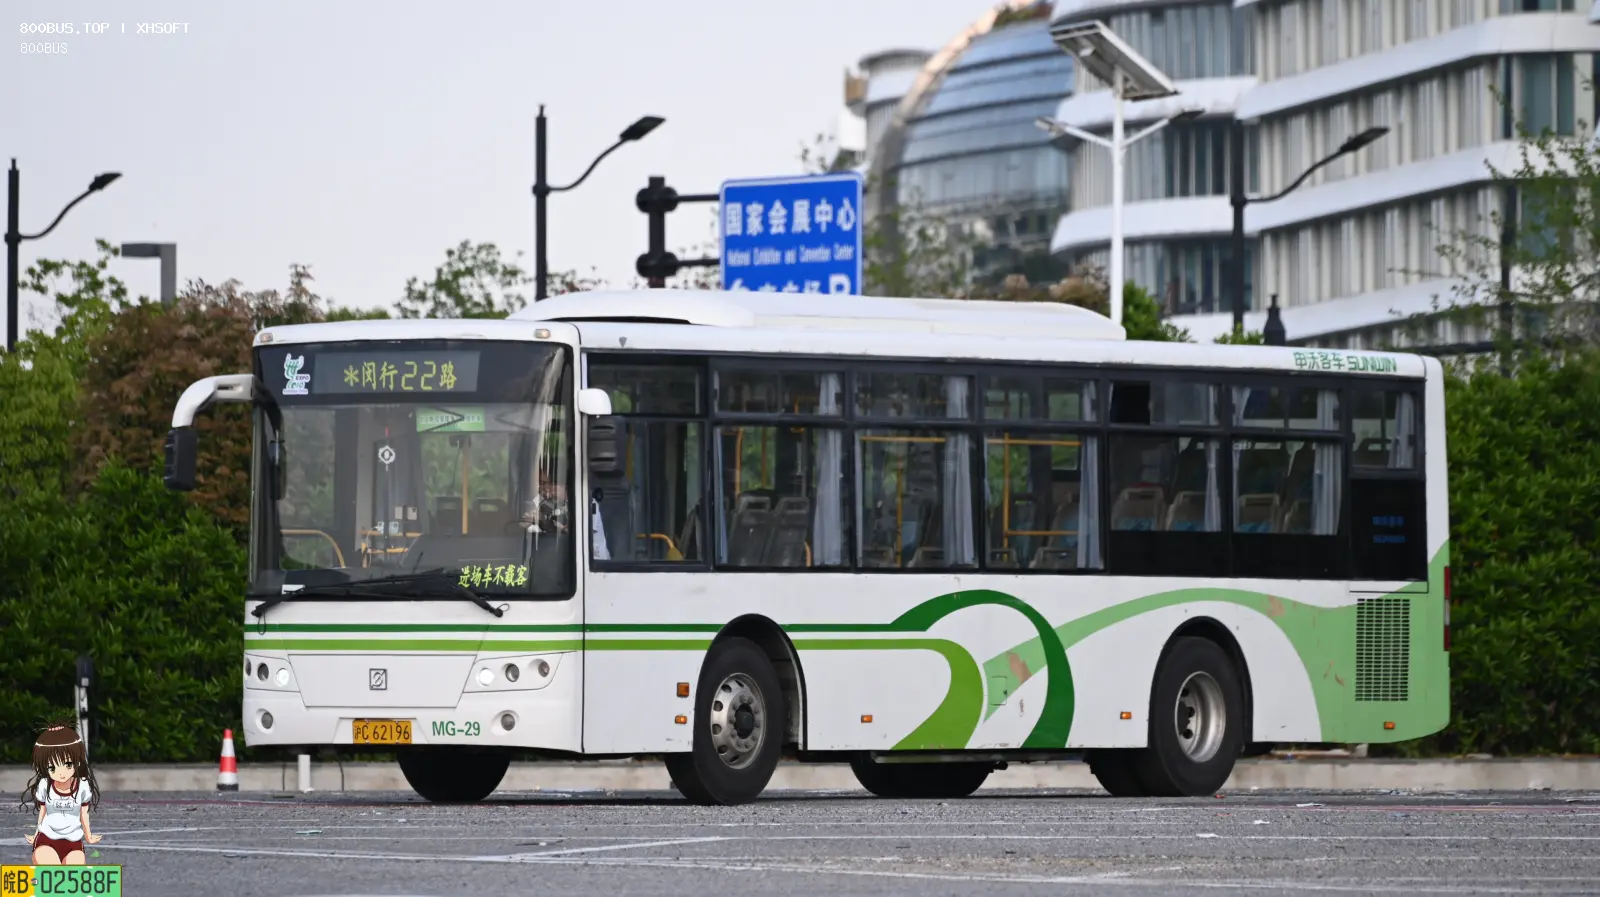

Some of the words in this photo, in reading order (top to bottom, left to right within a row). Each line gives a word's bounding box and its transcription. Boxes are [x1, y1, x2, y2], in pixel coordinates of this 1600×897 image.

[726, 198, 856, 236] 国家会展中心
[784, 246, 797, 265] and
[834, 243, 855, 261] Center
[1293, 351, 1345, 370] 申沃客车
[1346, 355, 1396, 372] SUNWIN
[458, 563, 527, 588] 进场车不载客
[432, 721, 481, 736] MG-29
